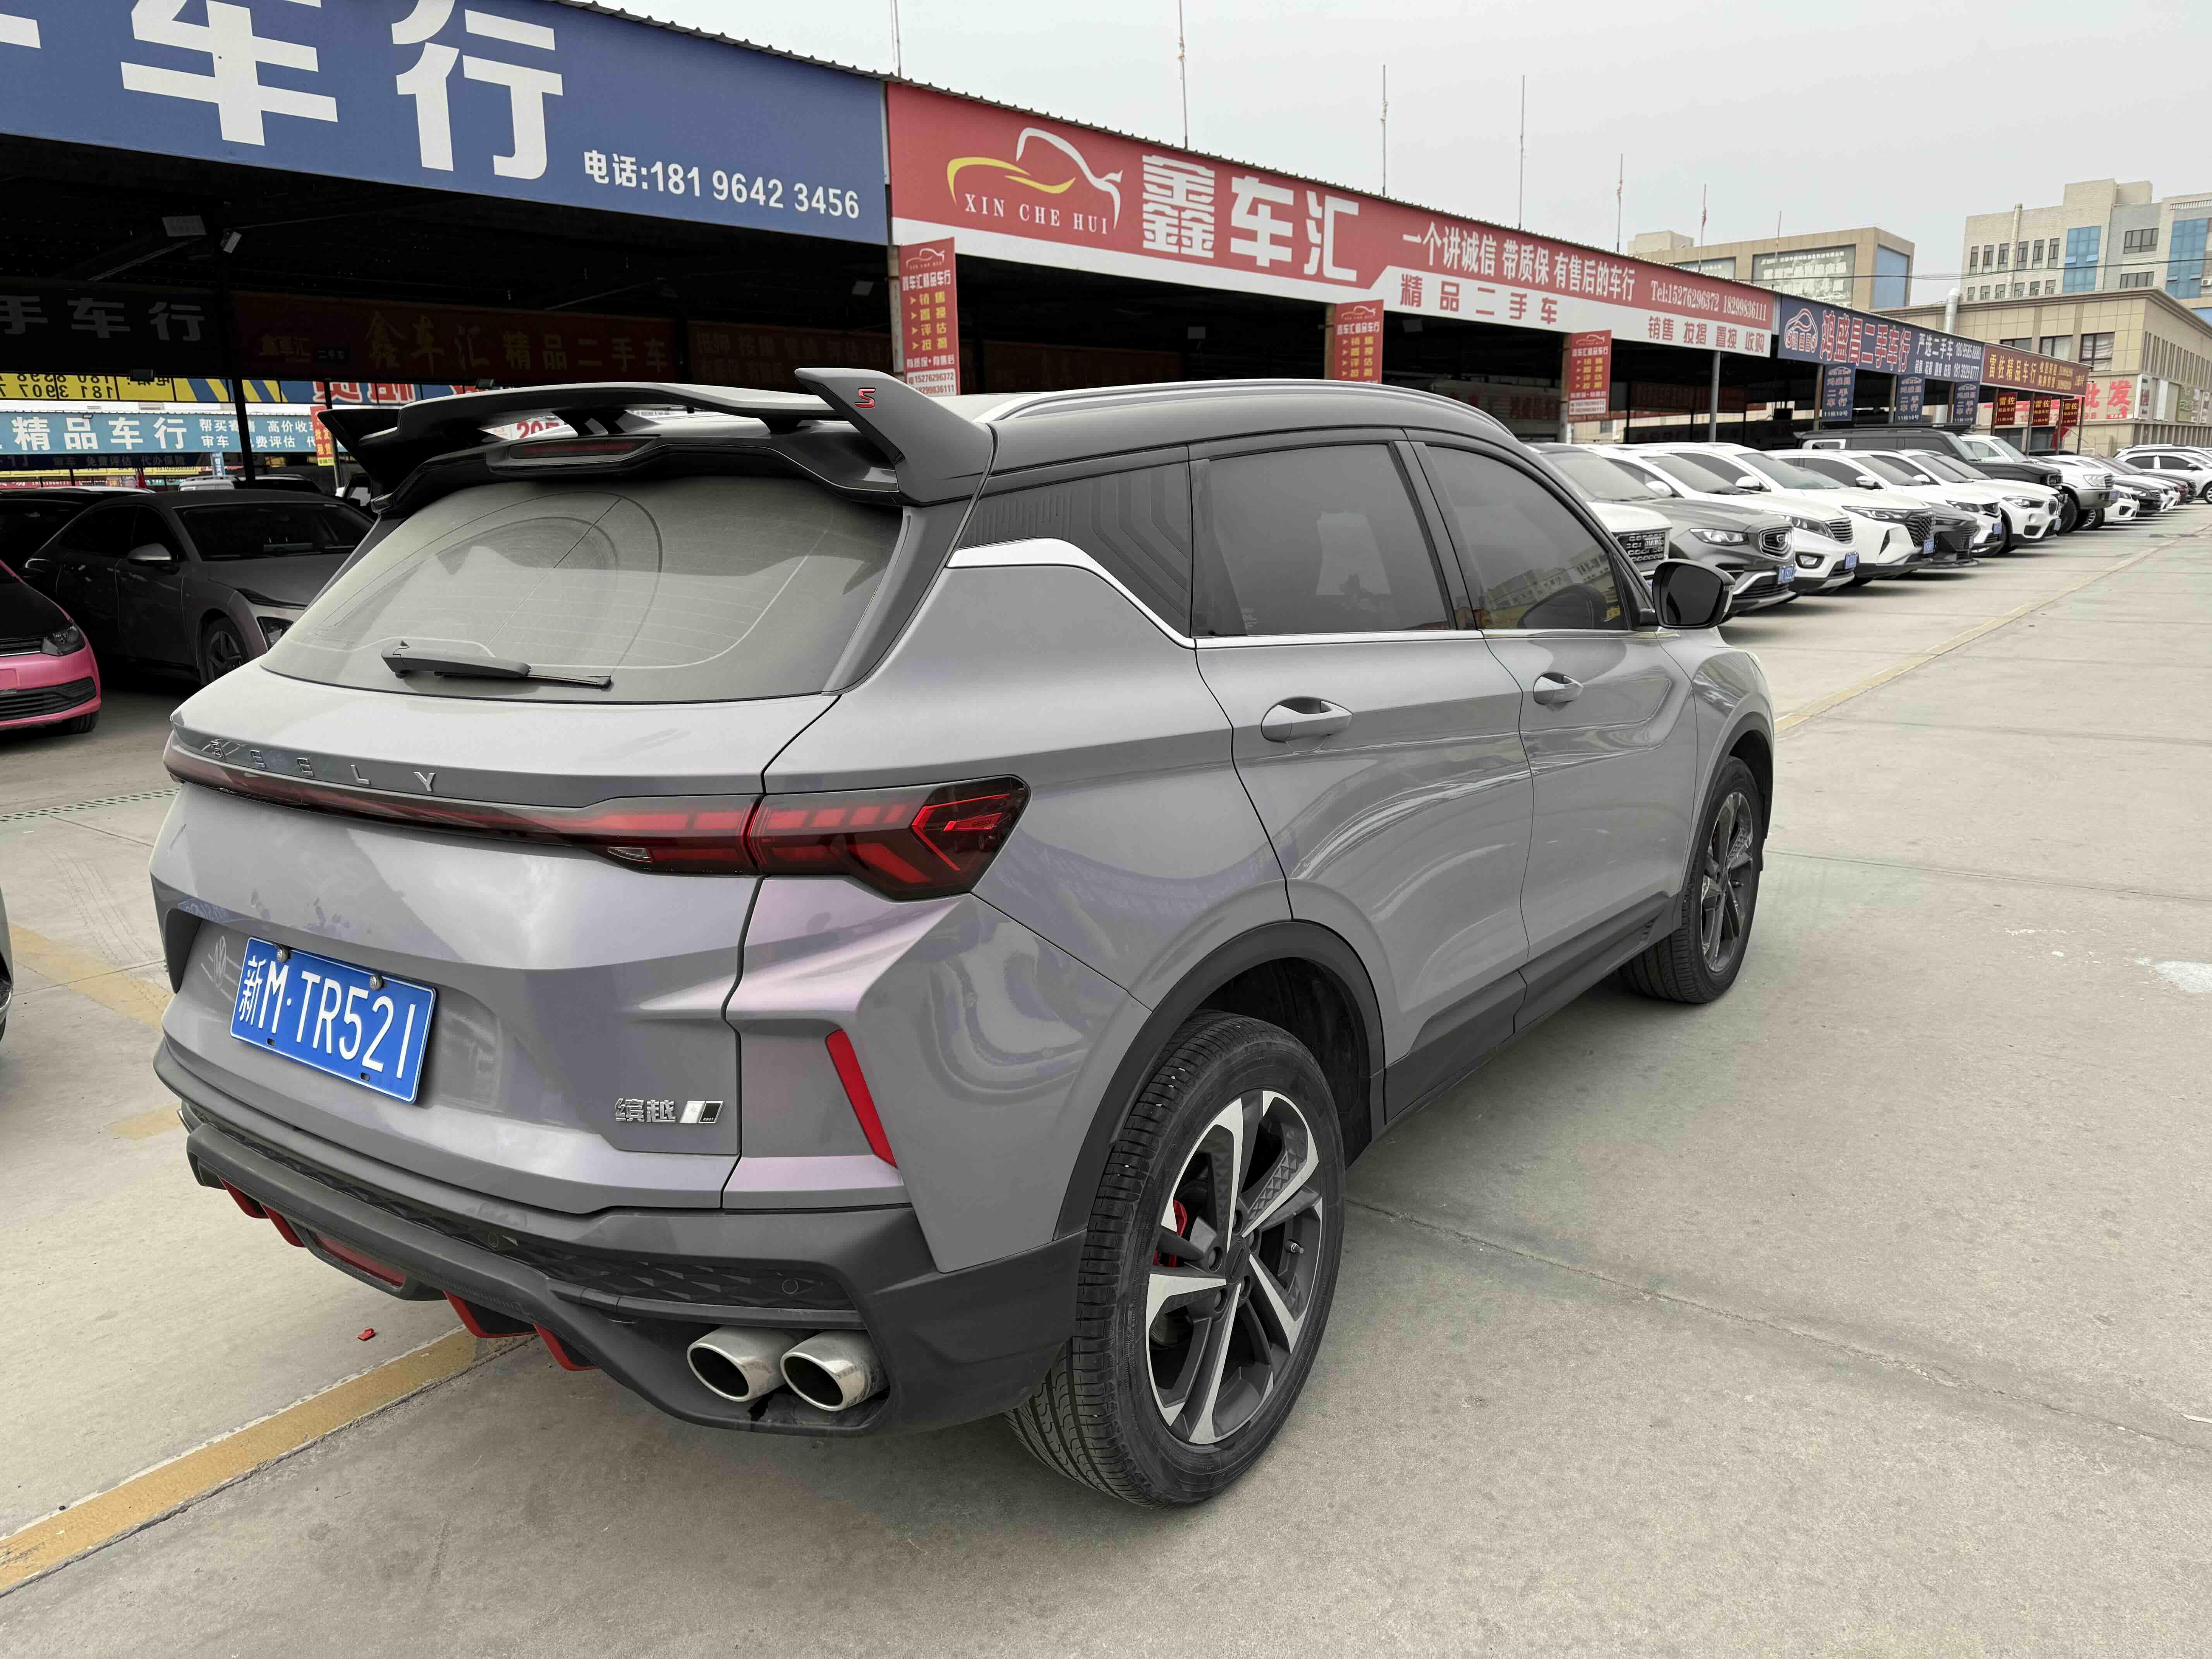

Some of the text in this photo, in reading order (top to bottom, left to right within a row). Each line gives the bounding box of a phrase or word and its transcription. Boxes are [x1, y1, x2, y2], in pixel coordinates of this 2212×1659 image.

[0, 0, 563, 180] 车行
[584, 150, 859, 218] 电话:181 9642 3456
[965, 193, 1107, 234] XIN CHE HUI
[1142, 155, 1359, 282] 鑫车汇
[1403, 221, 1636, 301] 一个讲诚信 带质保 有售后的车行
[1400, 274, 1558, 325] 精品二手车
[1649, 316, 1674, 341] 销售
[1684, 321, 1707, 345] 按揭
[1716, 326, 1737, 349] 置换
[1745, 331, 1764, 353] 收购
[12, 416, 187, 451] 精品车行
[201, 435, 230, 448] 审车
[251, 436, 296, 448] 费评估
[210, 740, 436, 792] GEELY
[615, 1098, 676, 1123] 缤越
